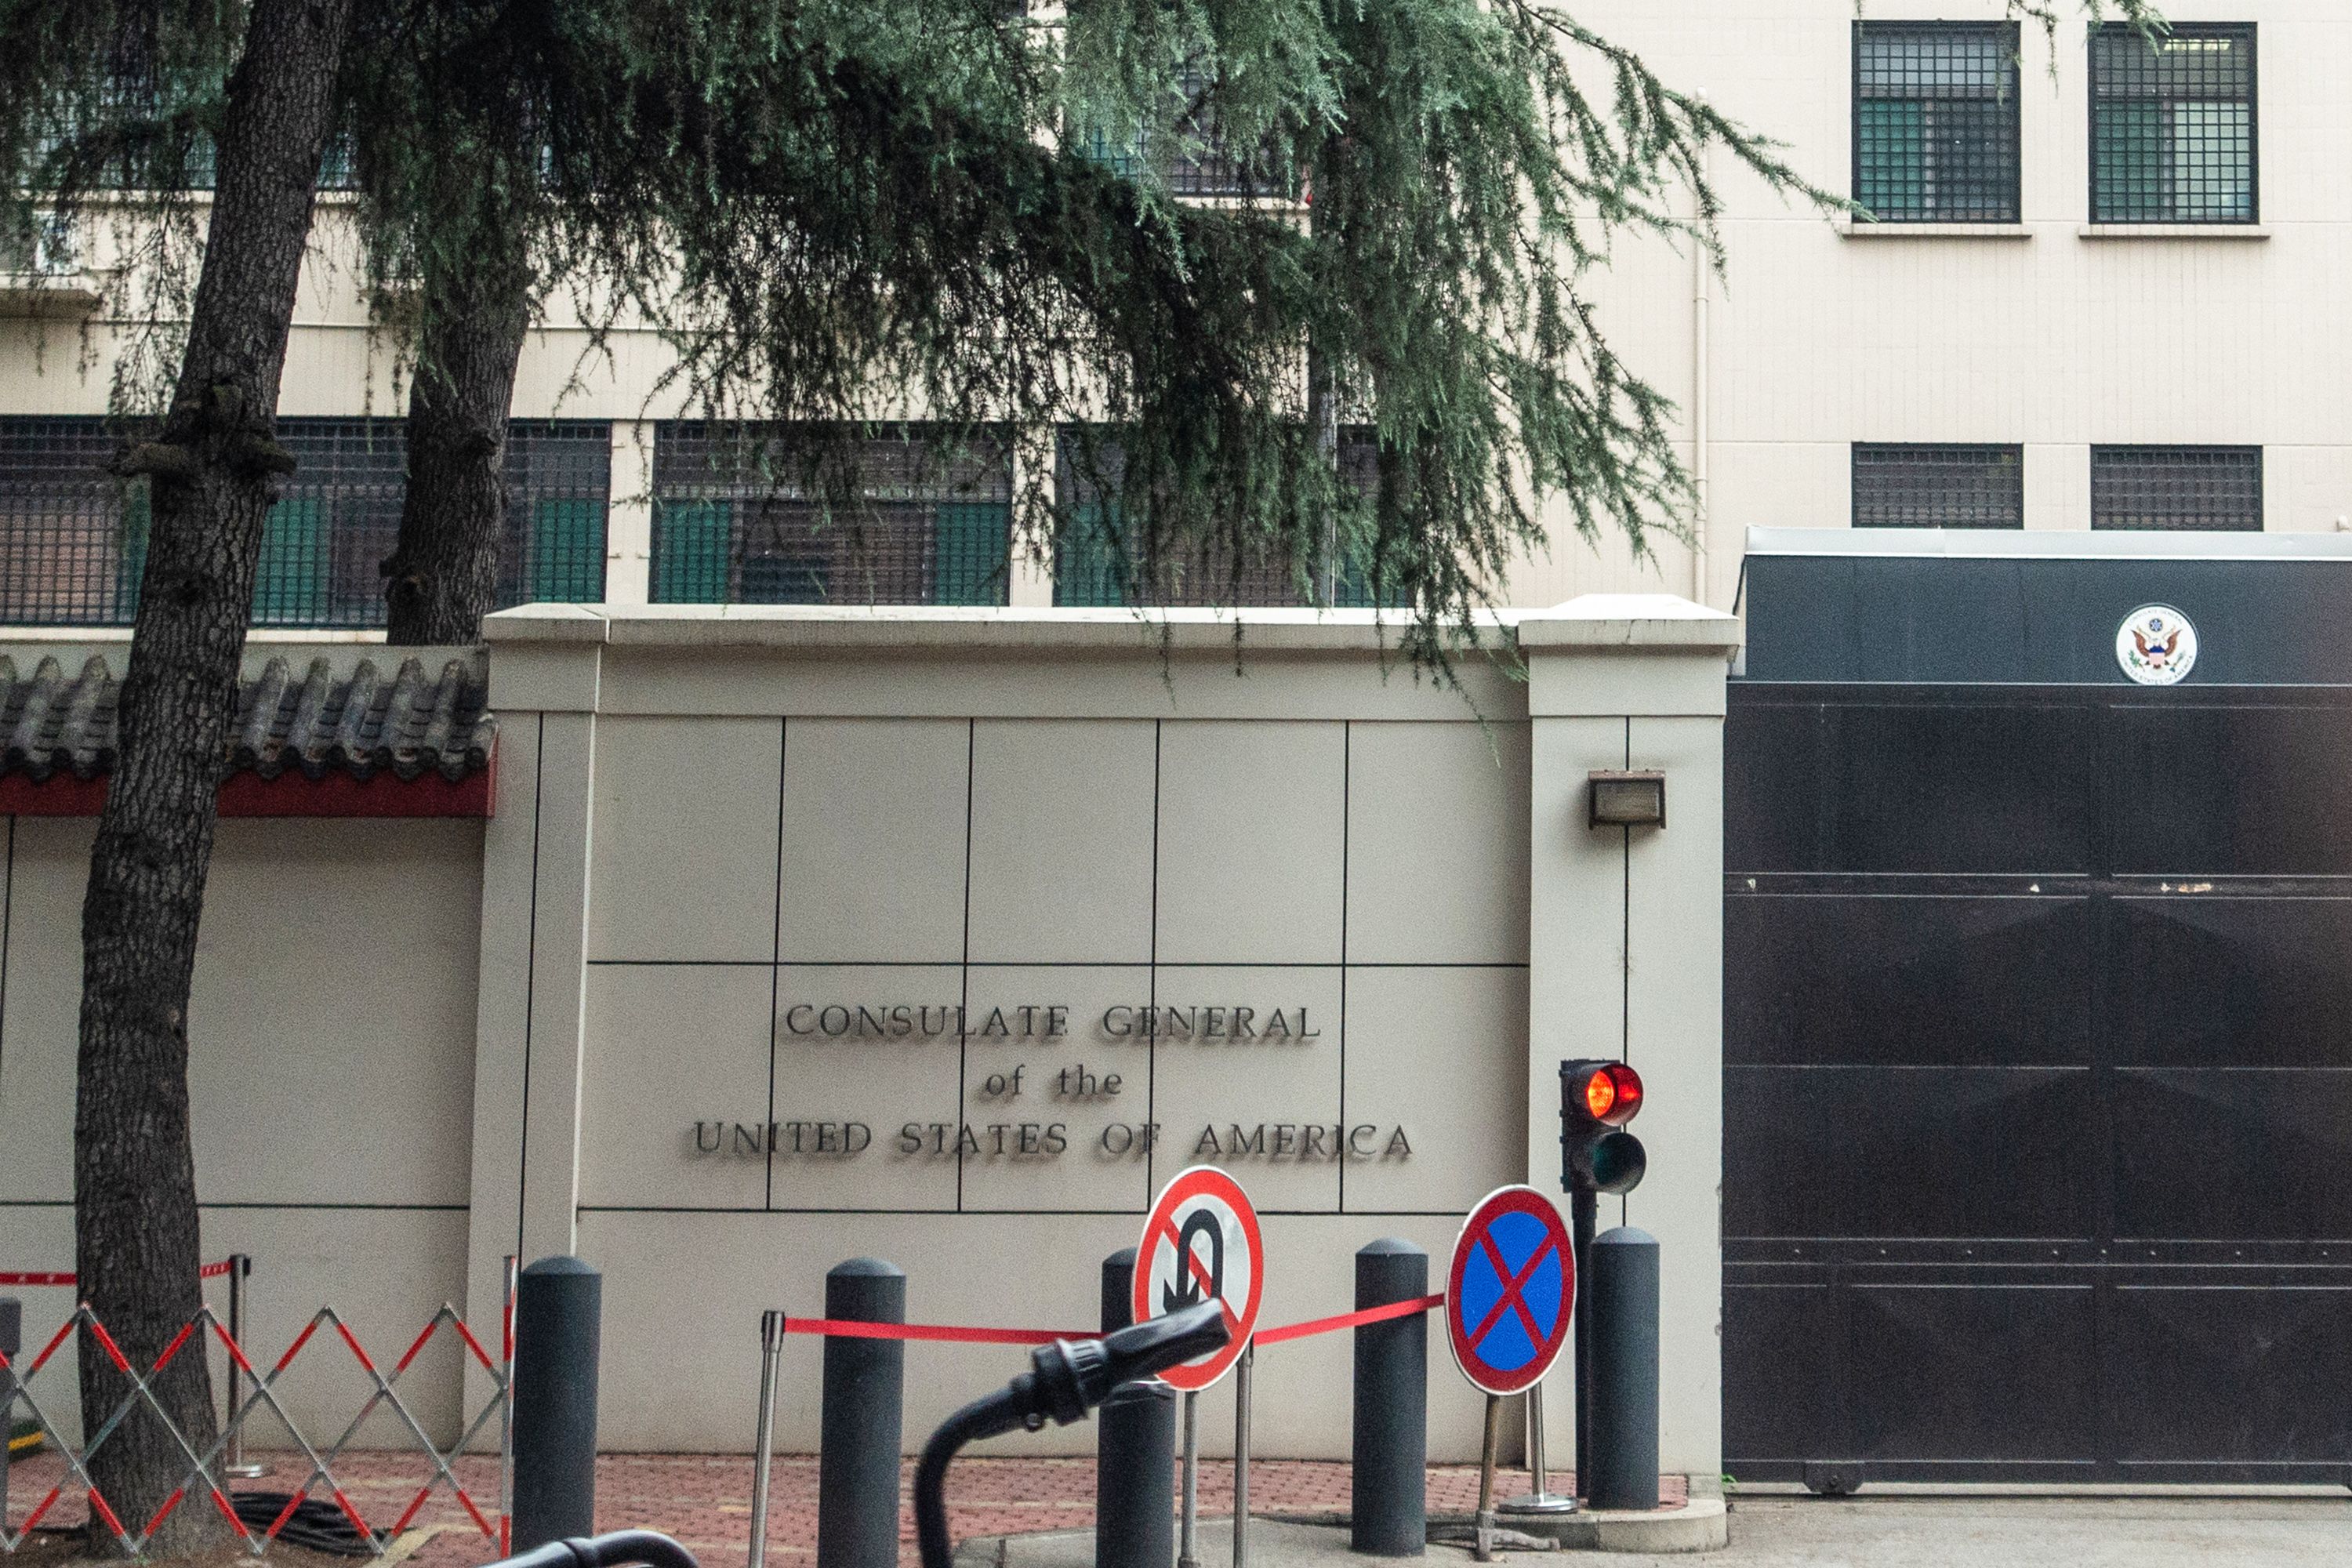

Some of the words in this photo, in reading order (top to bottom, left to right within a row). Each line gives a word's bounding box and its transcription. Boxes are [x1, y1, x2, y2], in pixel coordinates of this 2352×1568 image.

[786, 1004, 1069, 1036] CONSULATE
[1102, 1005, 1321, 1037] GENERAL
[985, 1064, 1025, 1096] of
[1058, 1063, 1123, 1096] the
[694, 1122, 872, 1153] UNITED
[901, 1123, 1068, 1155] STATES
[1102, 1123, 1161, 1155] OF
[1194, 1123, 1413, 1156] AMERICA
